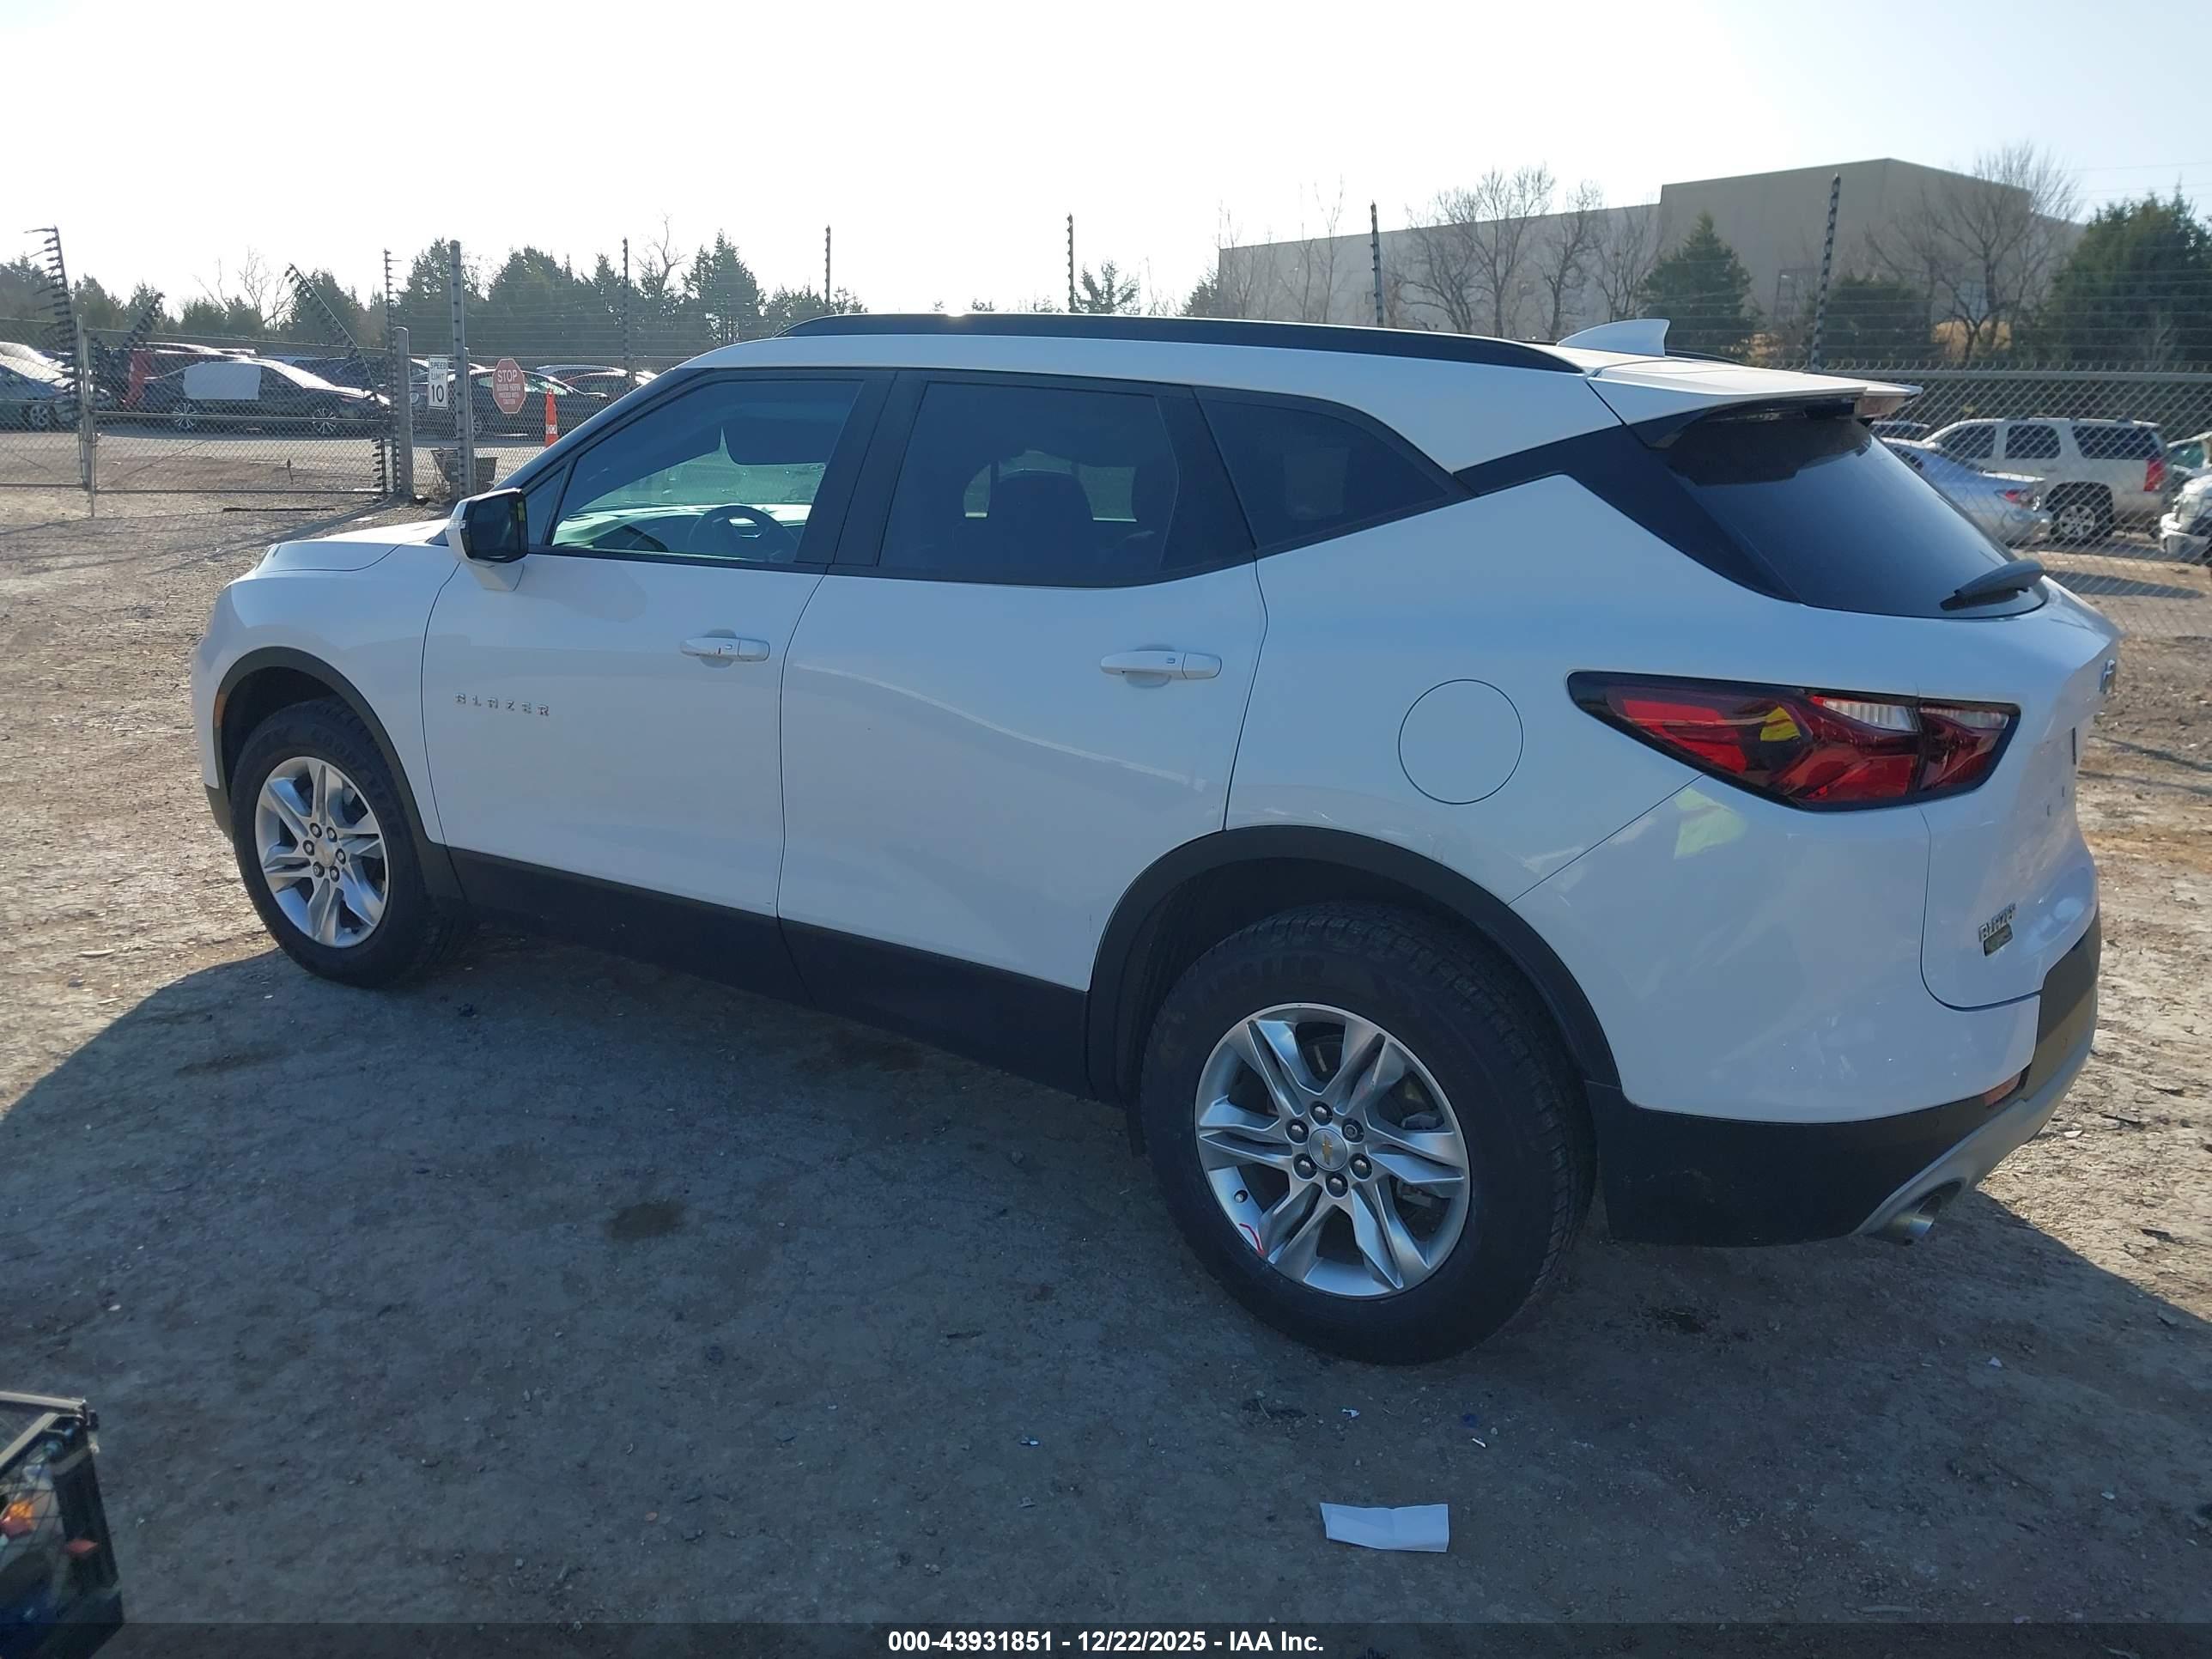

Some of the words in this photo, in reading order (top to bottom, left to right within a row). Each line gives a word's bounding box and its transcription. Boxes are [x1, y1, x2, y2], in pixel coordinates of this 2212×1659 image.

[497, 369, 518, 383] STOP
[431, 384, 445, 403] 10
[455, 692, 550, 716] BLAZER
